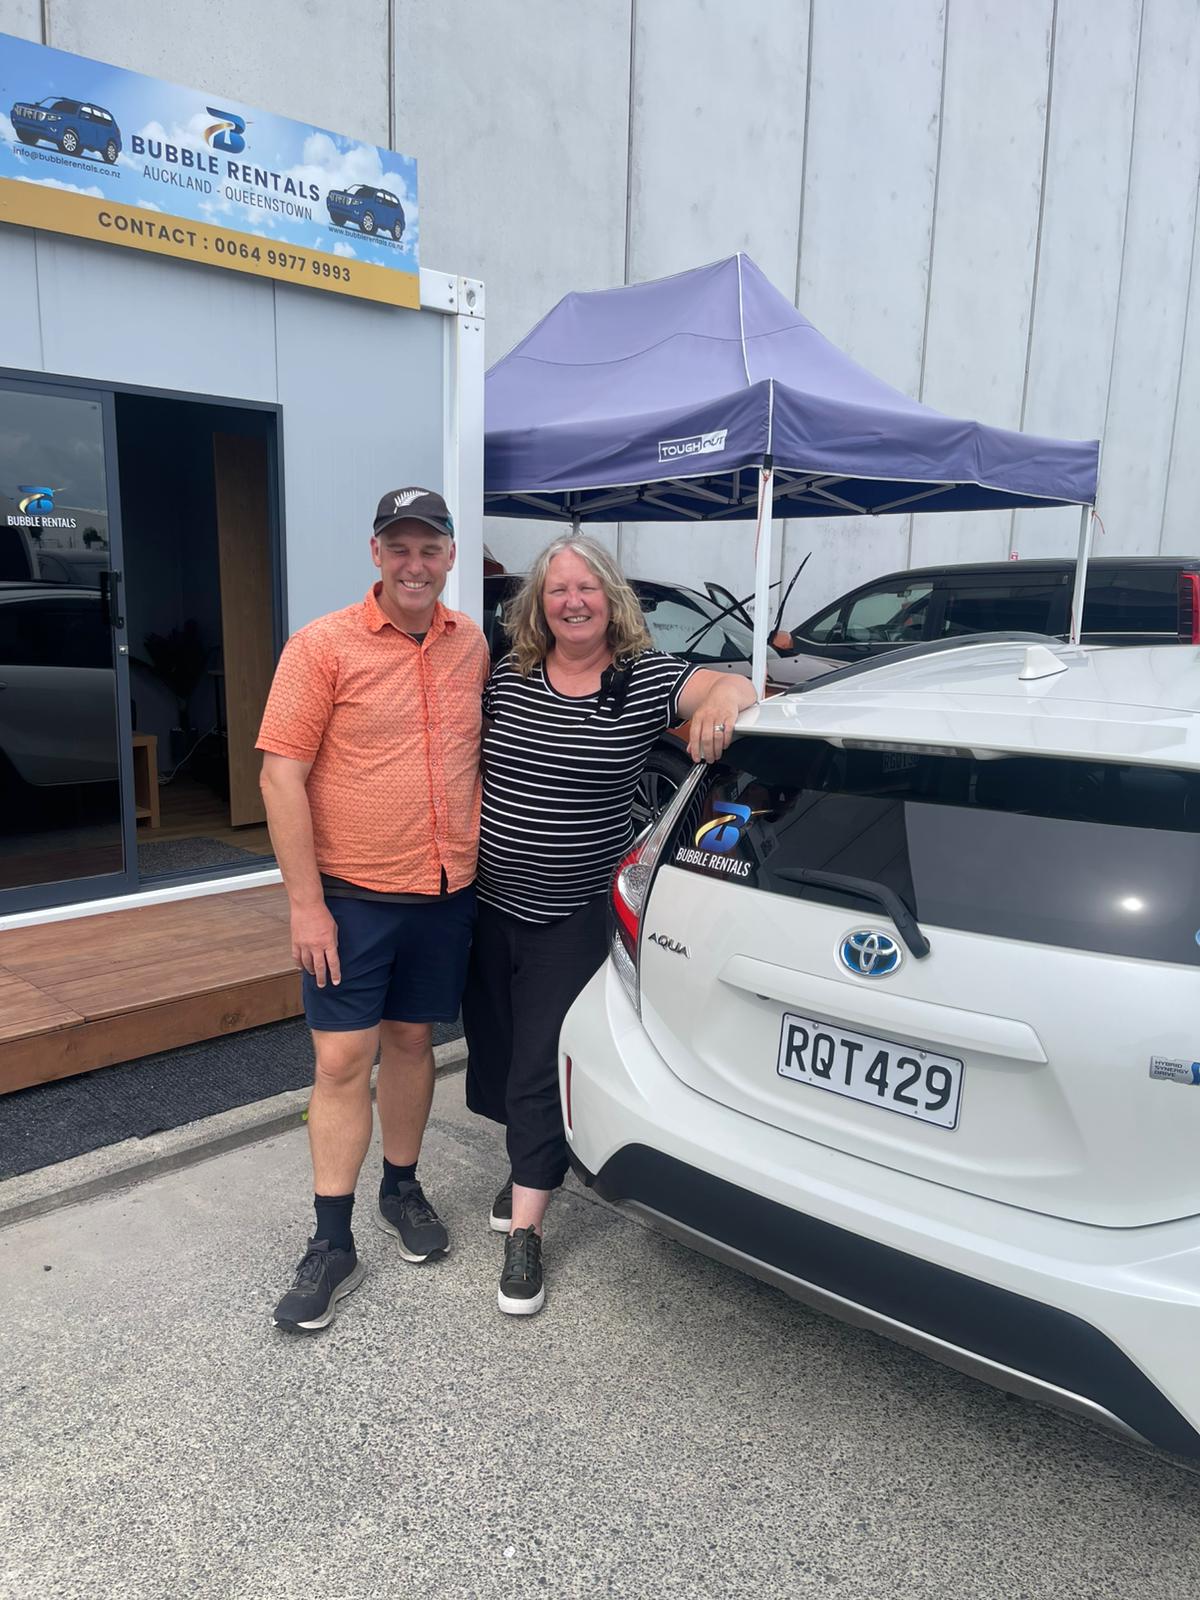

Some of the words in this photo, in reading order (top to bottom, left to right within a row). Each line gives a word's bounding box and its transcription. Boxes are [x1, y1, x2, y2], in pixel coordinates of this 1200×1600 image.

[13, 146, 121, 179] info@bubblerentals.co.nz
[131, 135, 219, 175] BUBBLE
[227, 161, 320, 202] RENTALS
[143, 165, 212, 194] AUCKLAND
[225, 186, 312, 221] QUEEENSTOWN
[98, 212, 196, 247] CONTACT
[215, 237, 261, 261] 0064
[267, 250, 306, 271] 9977
[312, 261, 351, 282] 9993
[7, 515, 40, 527] BUBBLE
[42, 517, 77, 529] RENTALS
[676, 847, 710, 867] BUBBLE
[709, 854, 751, 877] RENTALS
[648, 932, 690, 959] AQUA
[785, 1024, 952, 1111] RQT429
